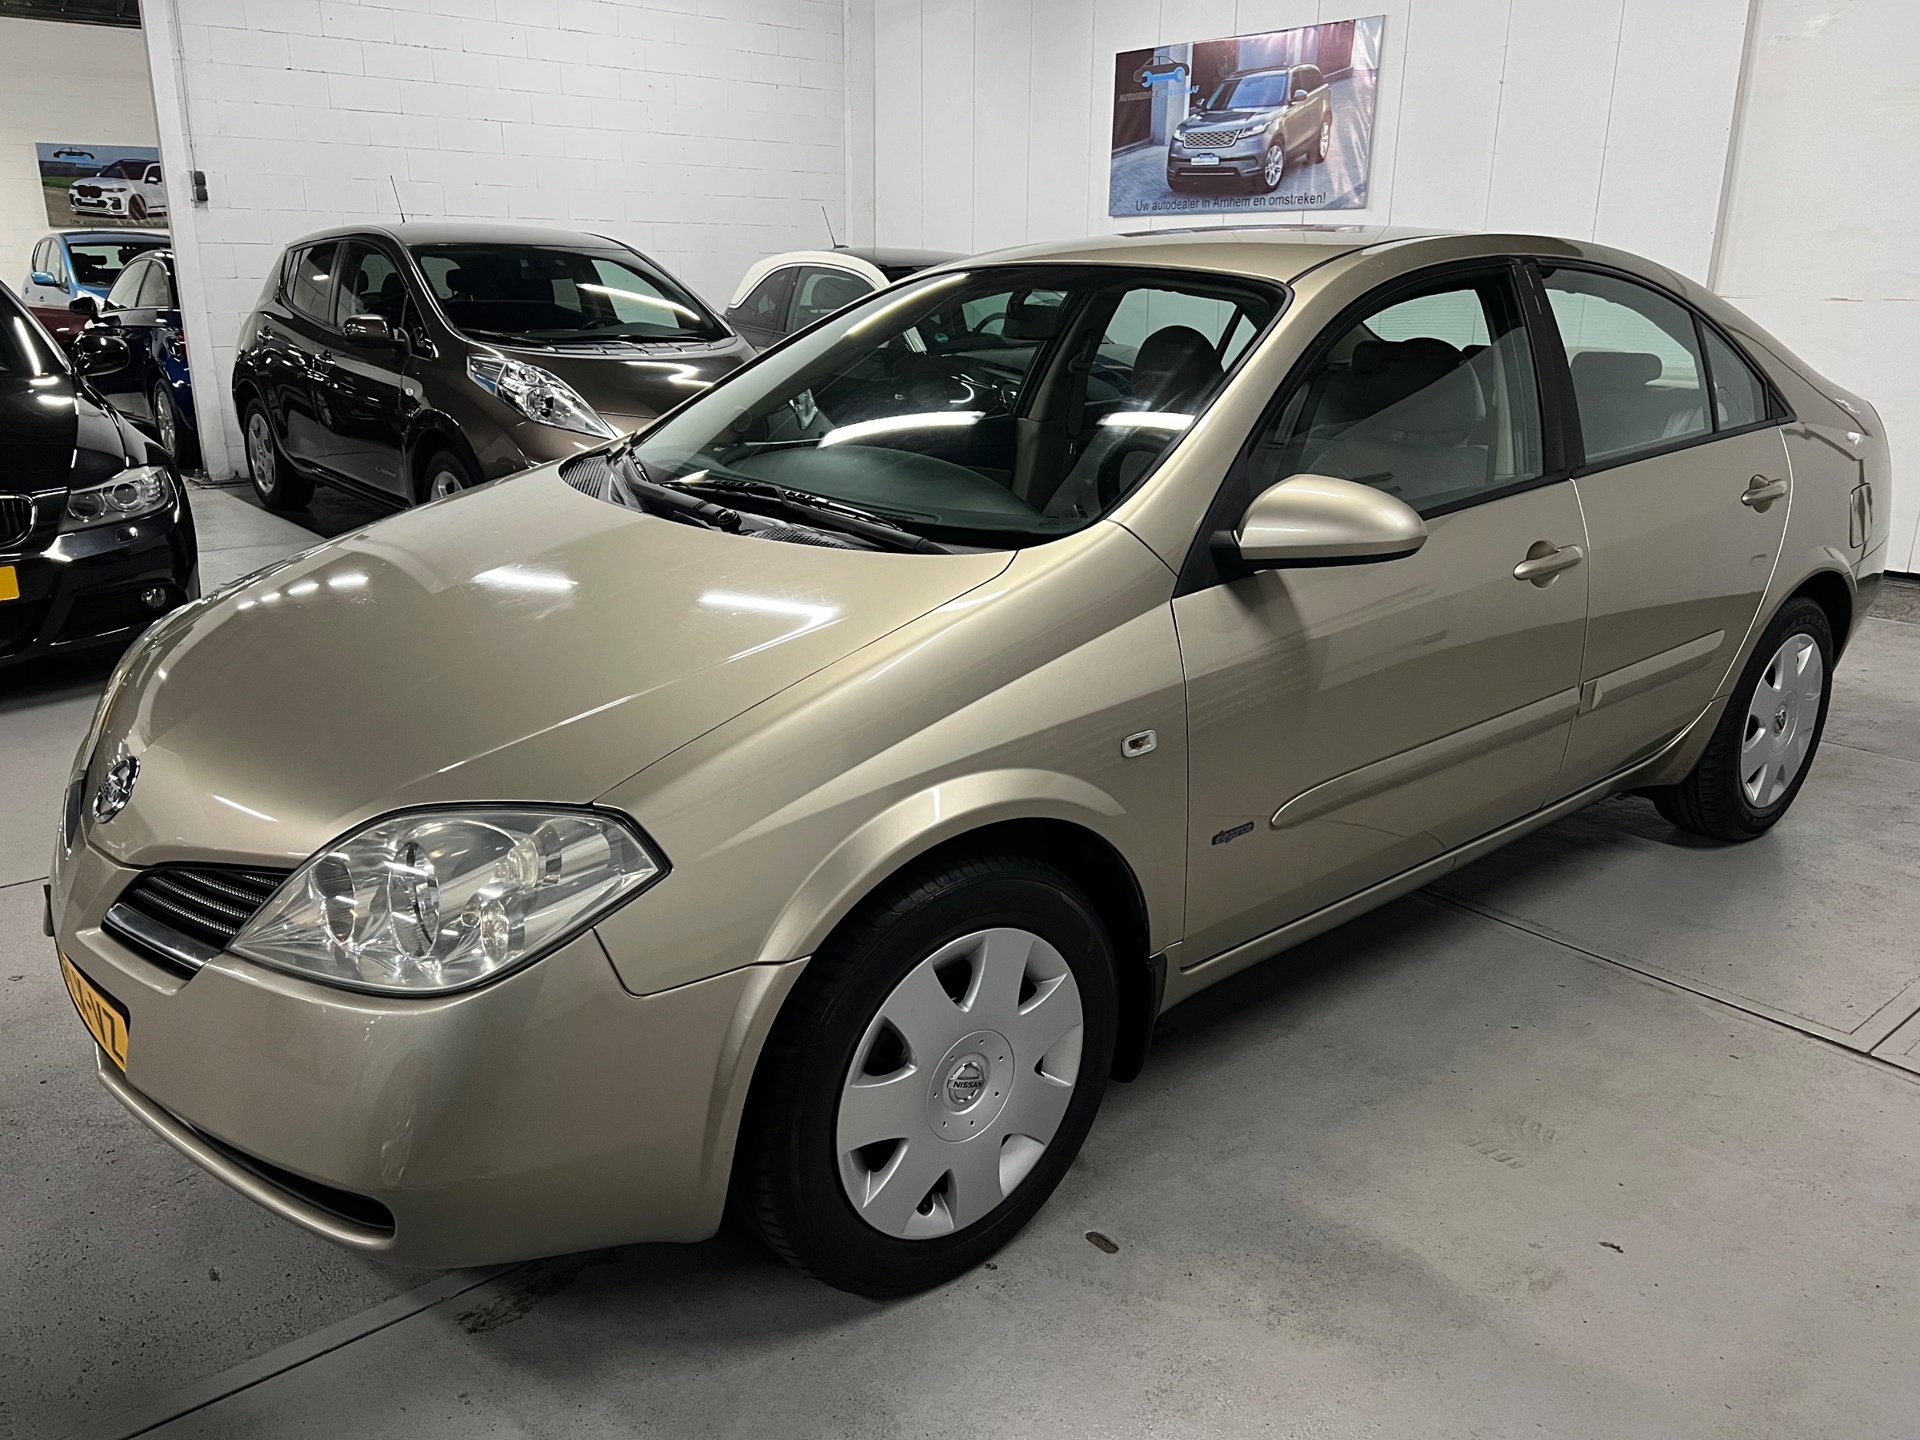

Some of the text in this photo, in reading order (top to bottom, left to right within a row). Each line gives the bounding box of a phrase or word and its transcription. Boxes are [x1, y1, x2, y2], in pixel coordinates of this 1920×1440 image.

[1136, 201, 1150, 211] Uw
[1152, 199, 1200, 211] autodealer
[1202, 198, 1210, 208] in
[1253, 197, 1266, 206] en
[1268, 192, 1327, 206] omstreken!
[1214, 824, 1254, 843] elegance
[953, 1081, 983, 1089] NISSAN
